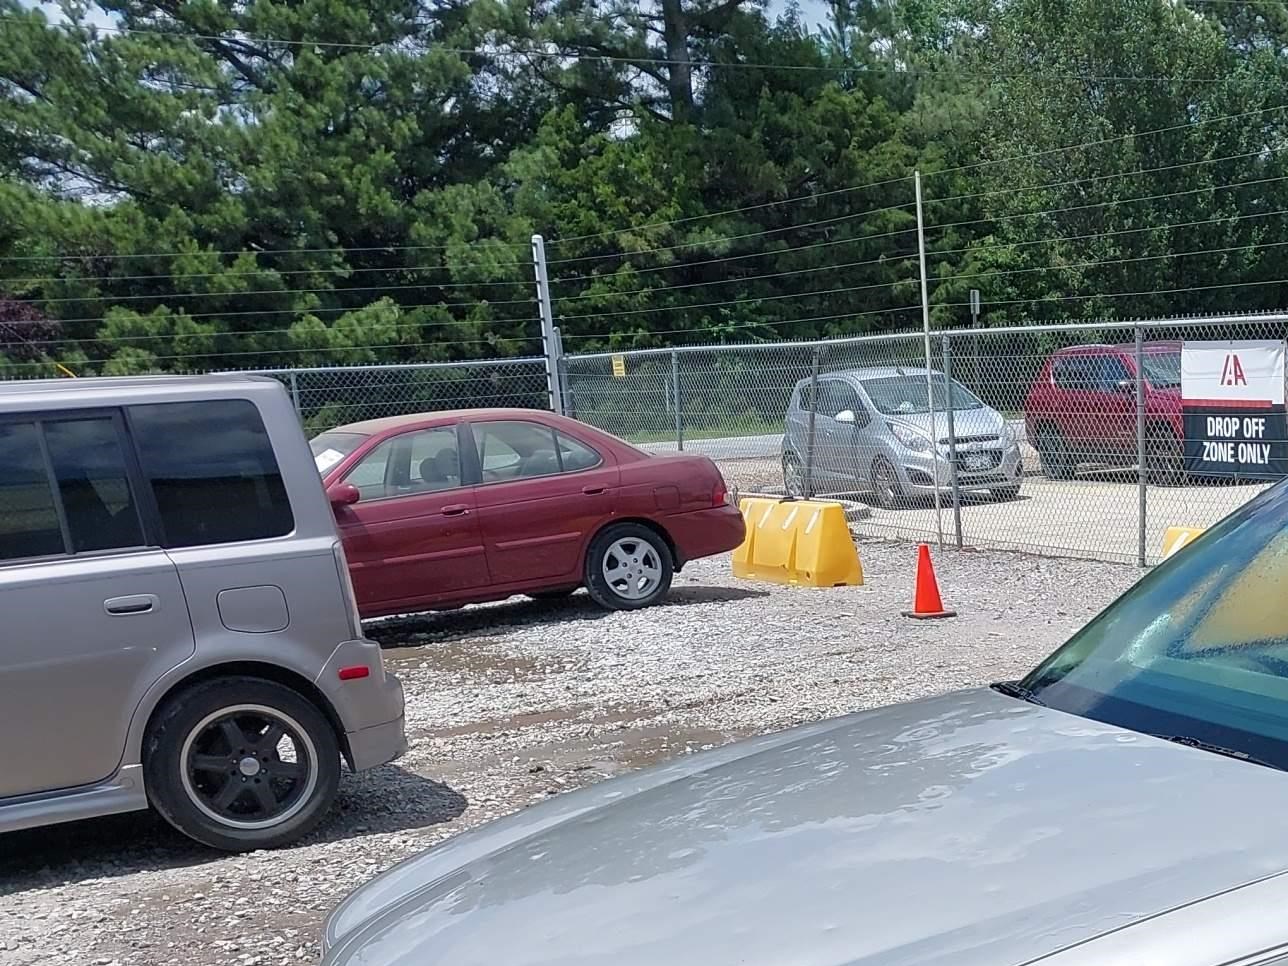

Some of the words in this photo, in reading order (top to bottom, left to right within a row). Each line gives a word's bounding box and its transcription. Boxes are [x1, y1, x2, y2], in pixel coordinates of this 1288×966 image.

[1207, 417, 1240, 437] DROP
[1243, 418, 1266, 438] OFF
[1203, 442, 1235, 462] ZONE
[1238, 443, 1271, 464] ONLY
